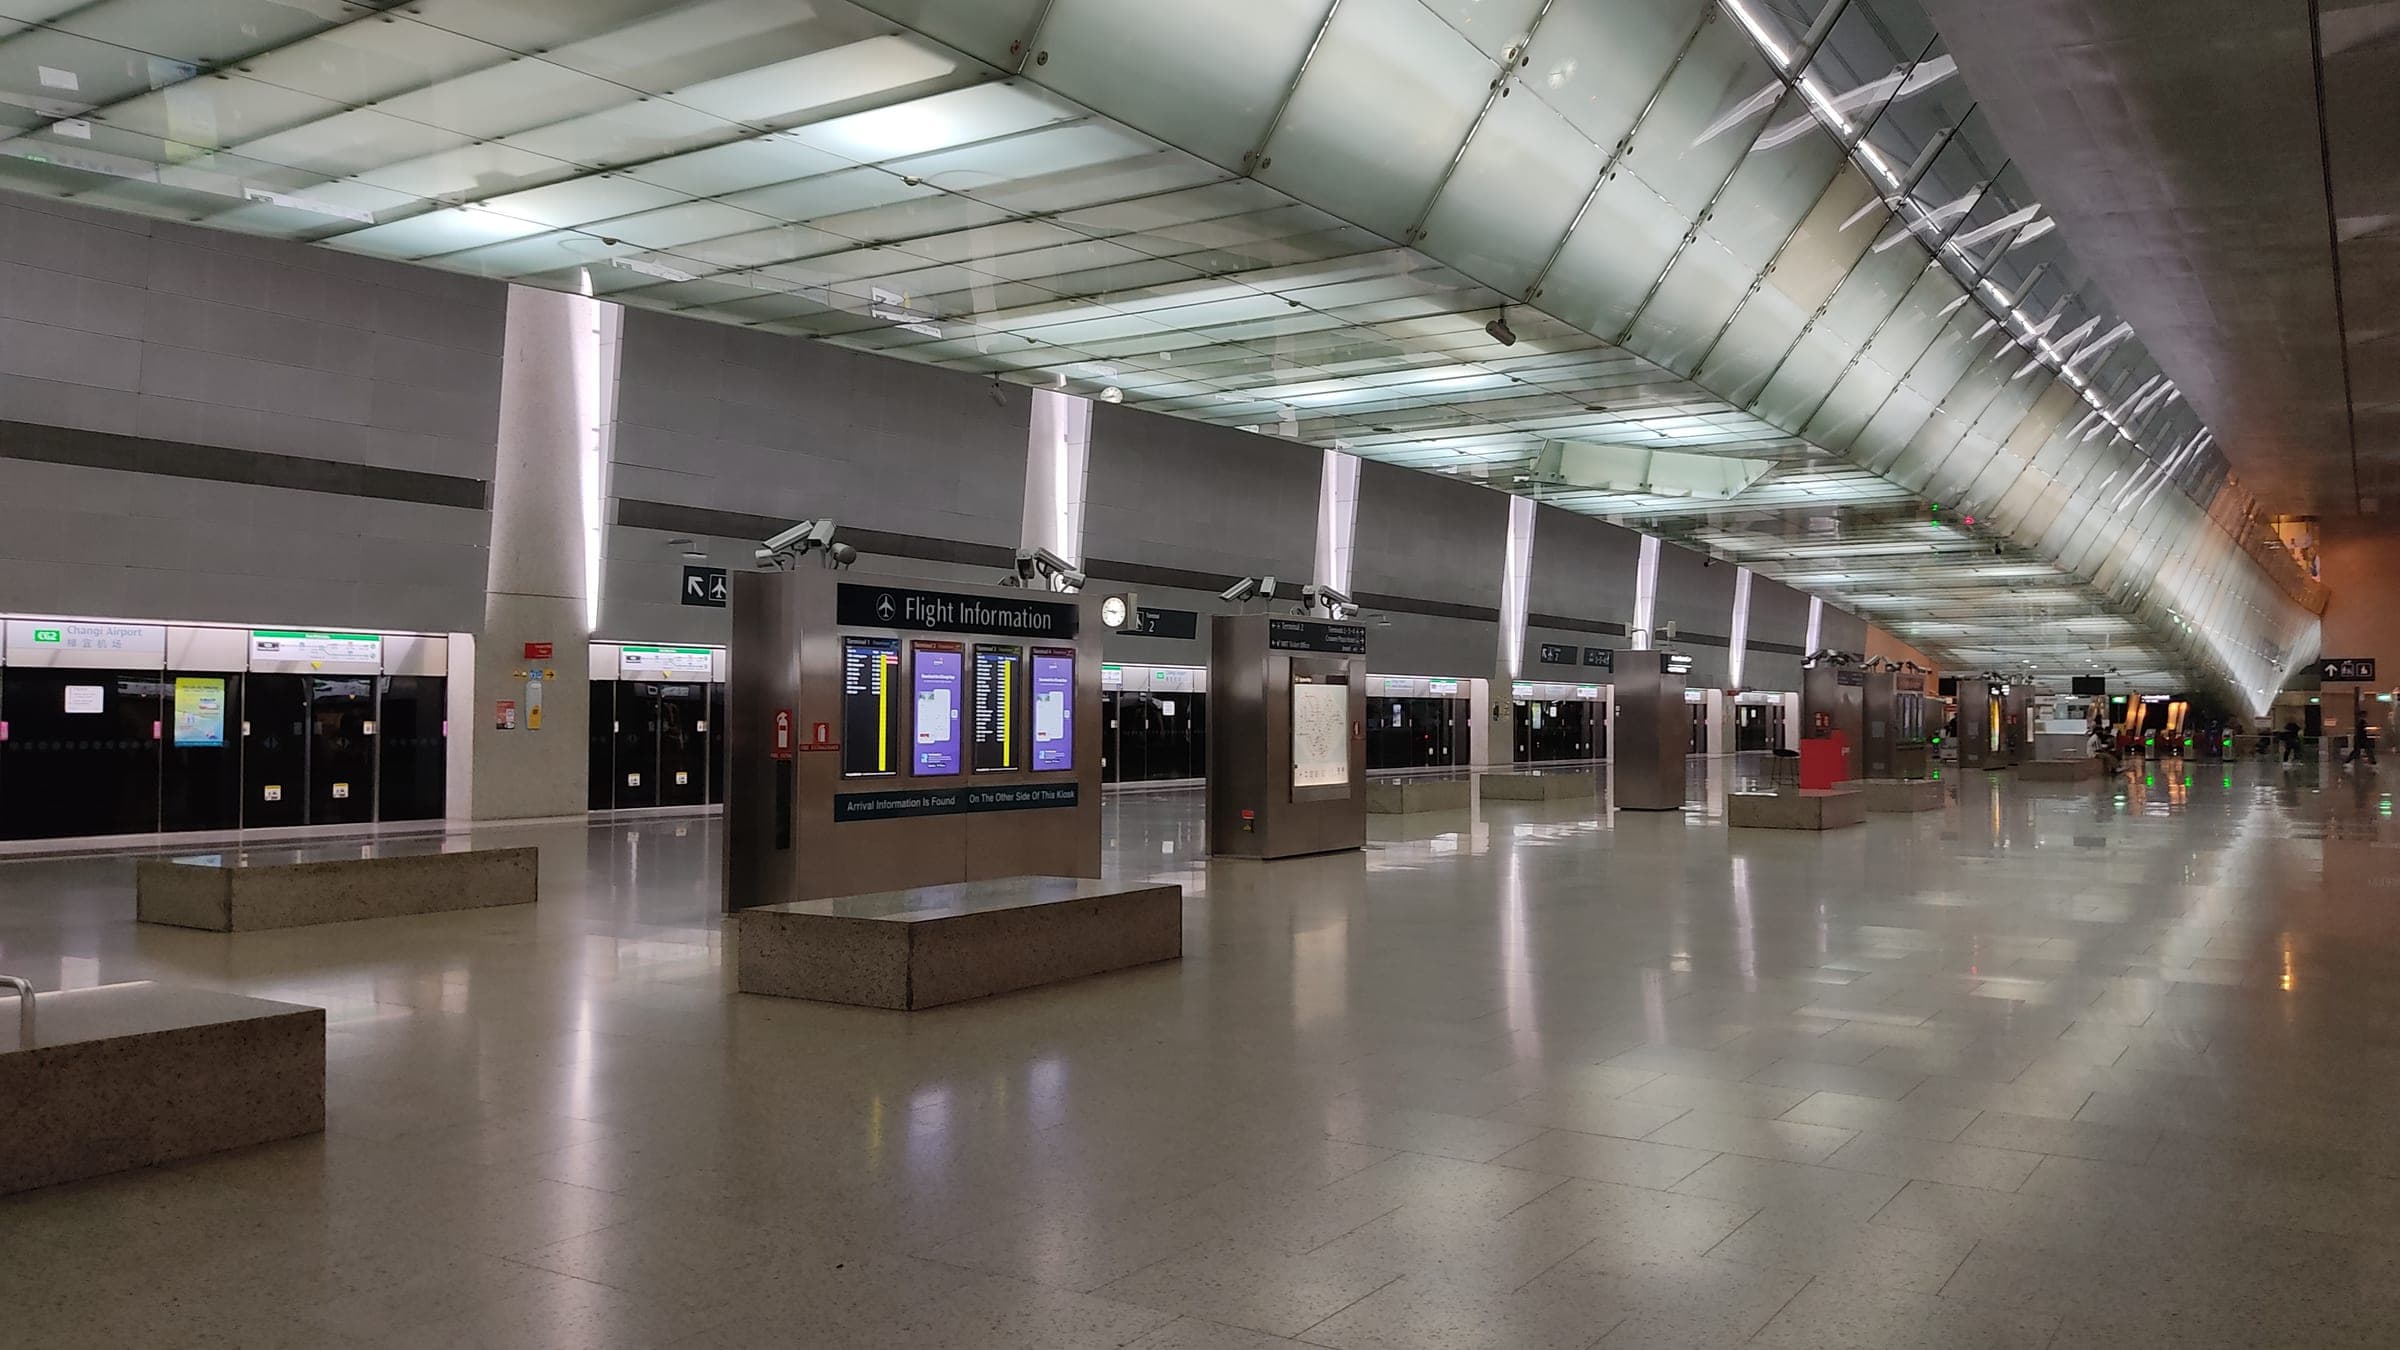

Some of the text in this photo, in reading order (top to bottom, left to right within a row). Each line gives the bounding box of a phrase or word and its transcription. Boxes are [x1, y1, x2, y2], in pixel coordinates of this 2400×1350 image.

[905, 597, 1052, 630] Flight Information
[67, 625, 143, 638] Changi Airport
[1149, 621, 1155, 632] 2
[847, 796, 956, 812] Arrival Information Is Found
[969, 788, 1075, 804] On The Other Side Of This Kiosk
